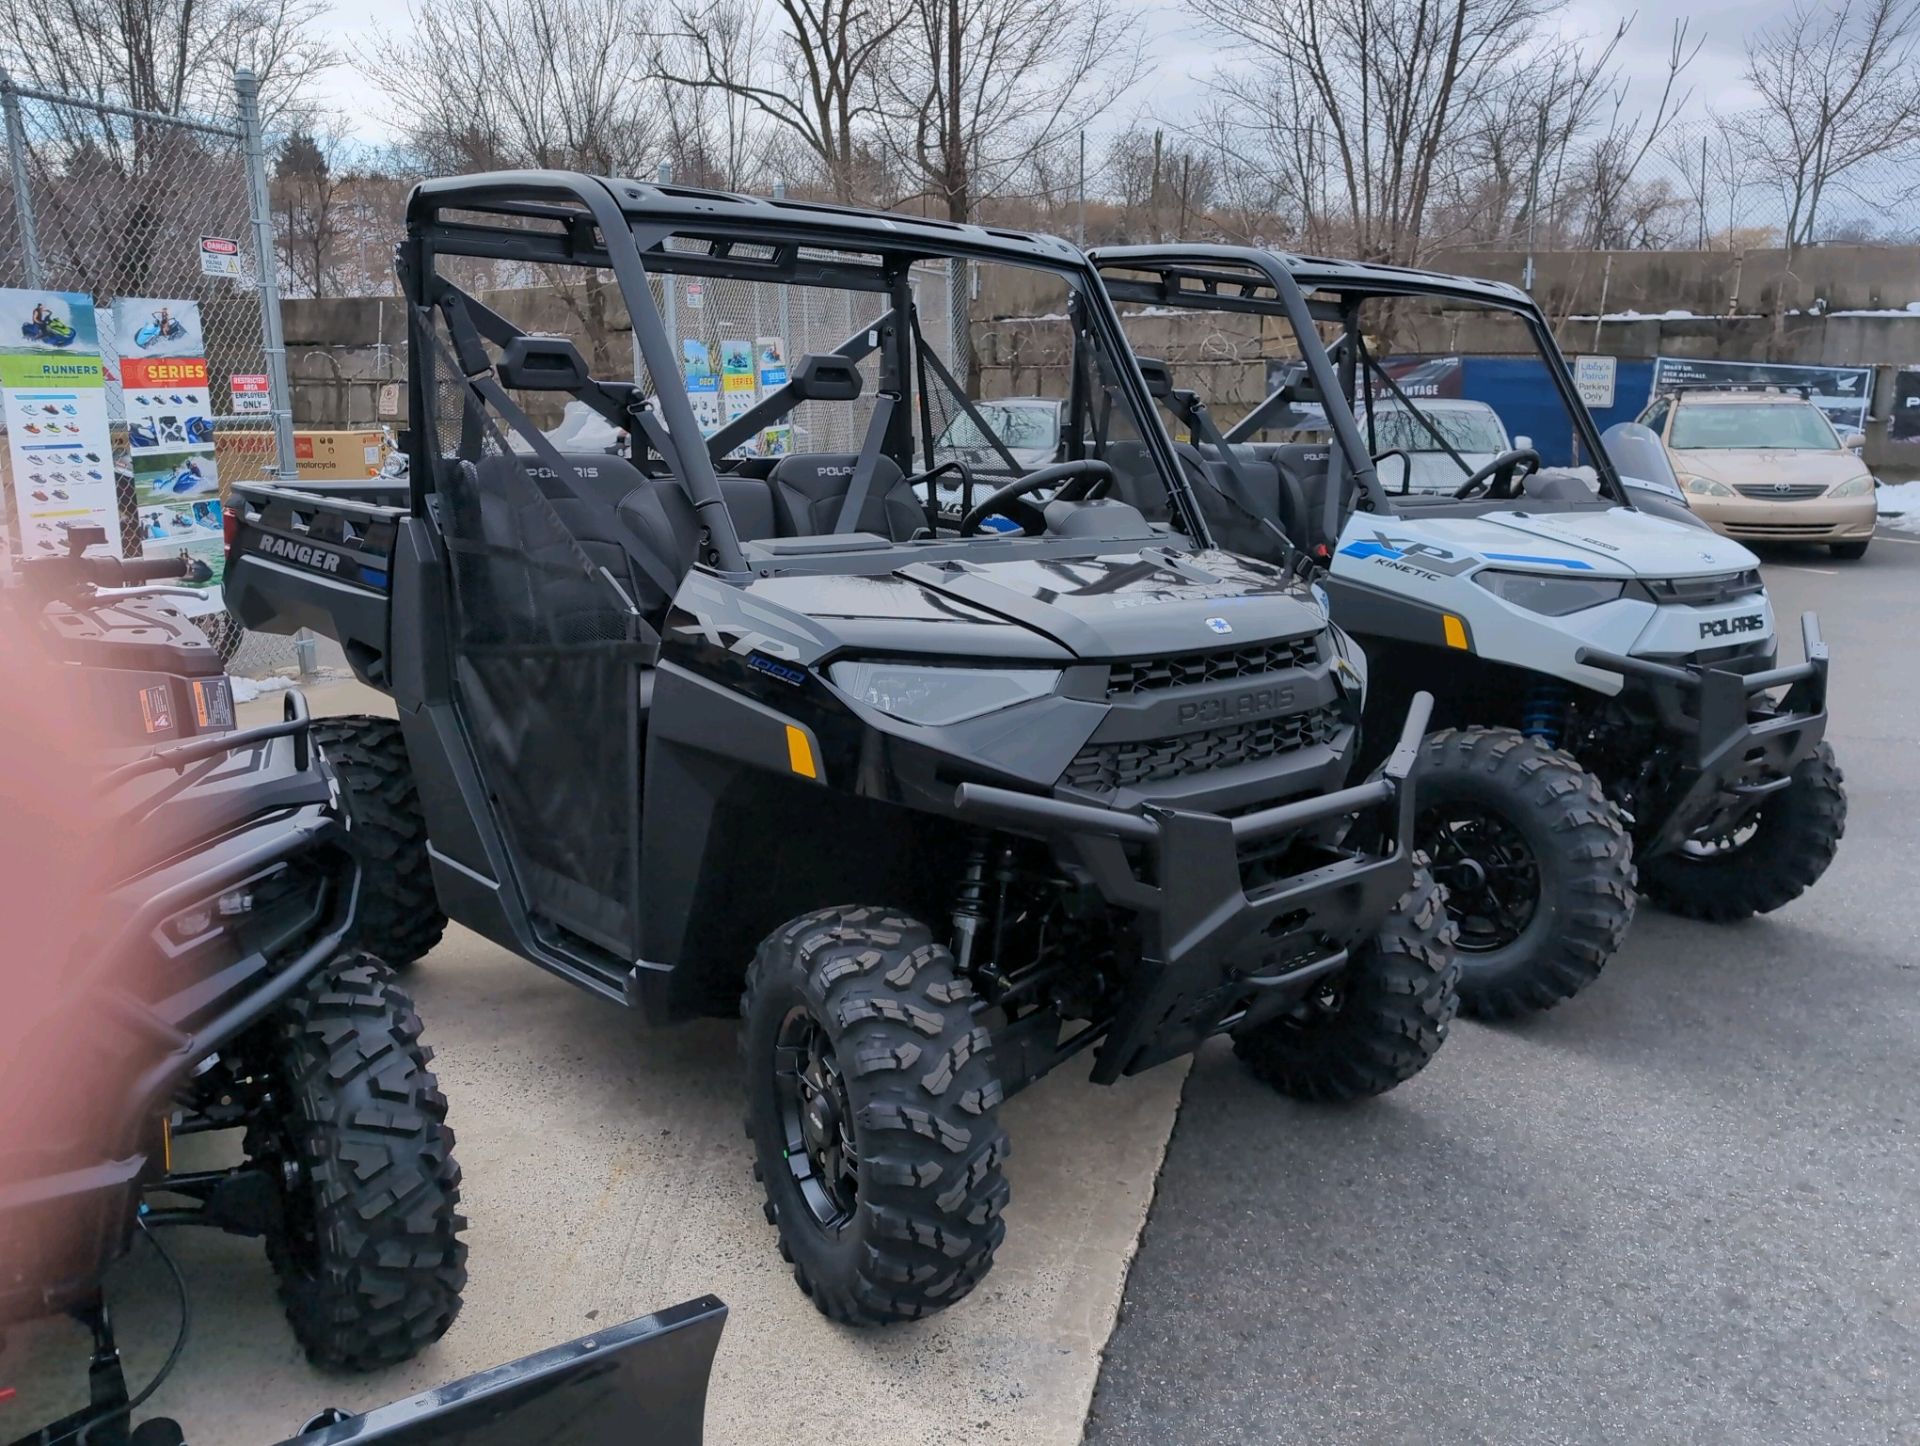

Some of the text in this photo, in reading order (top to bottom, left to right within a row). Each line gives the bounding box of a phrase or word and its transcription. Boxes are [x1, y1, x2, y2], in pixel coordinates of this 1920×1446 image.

[206, 241, 234, 251] DANGER
[42, 365, 99, 375] RUNNERS
[147, 365, 205, 378] SERIES
[732, 378, 753, 386] SERIES
[1579, 383, 1609, 392] Parking
[1584, 392, 1602, 401] Only
[243, 401, 261, 409] ONLY
[296, 461, 337, 470] motorcycle
[526, 467, 599, 478] POLRIS
[1353, 530, 1454, 559] XP
[259, 534, 341, 572] RANGER
[1375, 558, 1441, 582] KINETIC
[1699, 614, 1763, 639] POLARIS
[671, 610, 801, 660] XP
[750, 655, 805, 683] 1000
[1178, 686, 1295, 725] POLARIS
